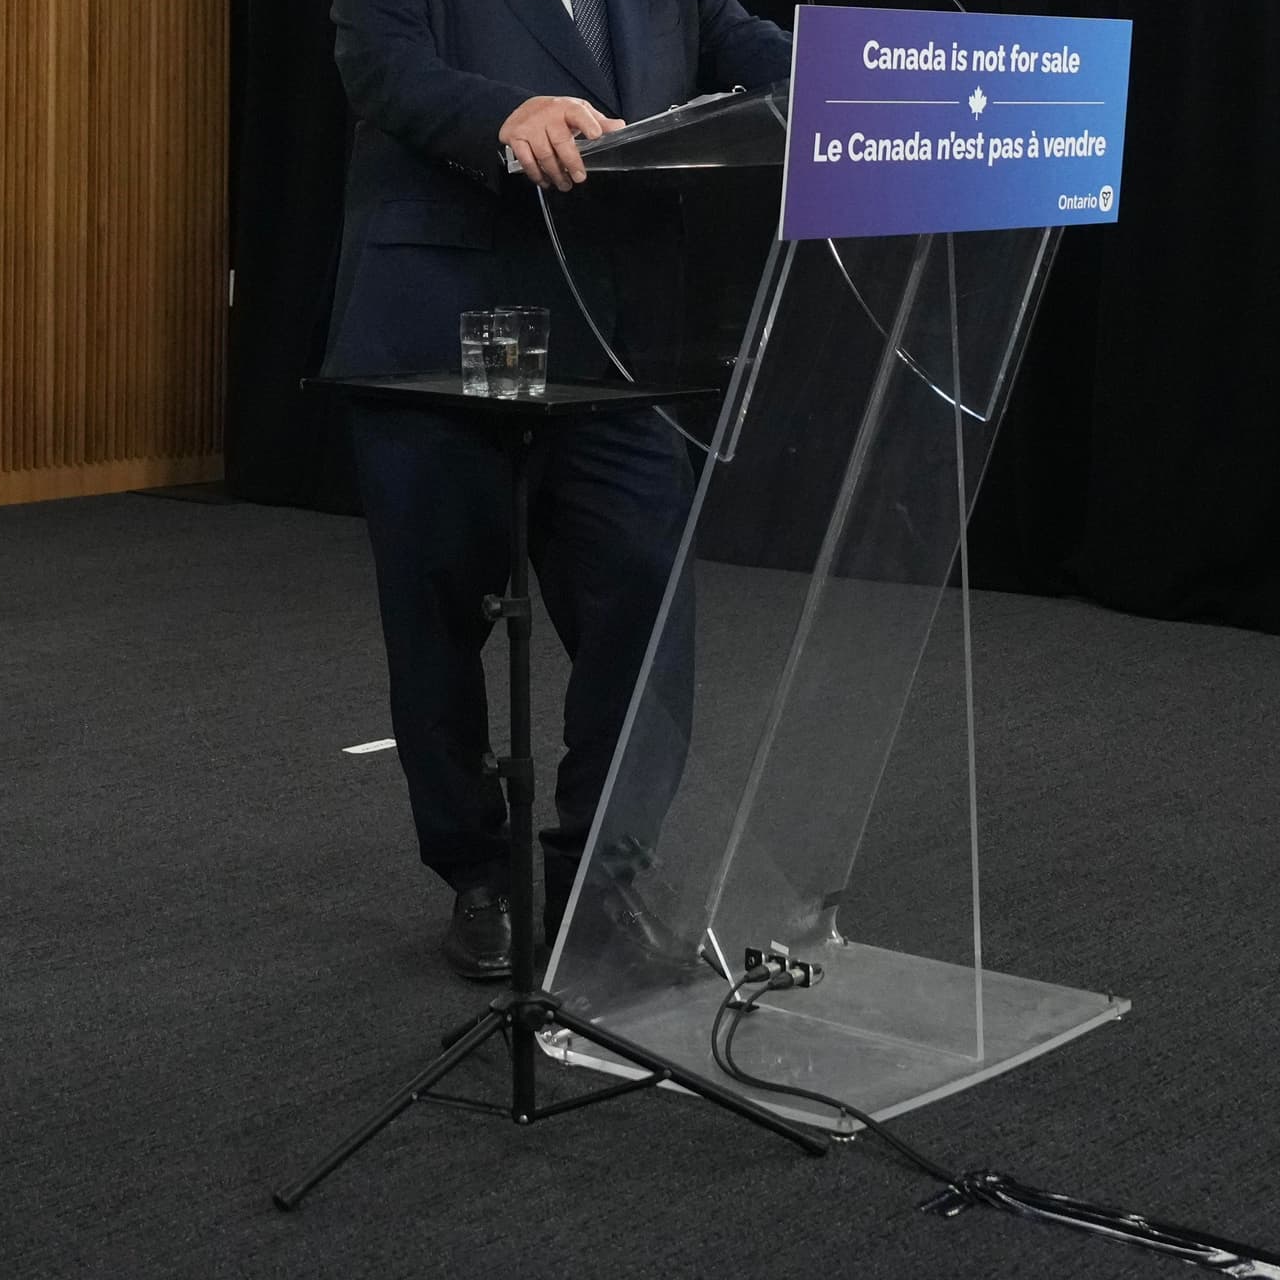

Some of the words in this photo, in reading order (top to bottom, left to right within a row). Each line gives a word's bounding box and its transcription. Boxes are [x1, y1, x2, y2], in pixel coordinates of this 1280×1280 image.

[862, 39, 946, 71] Canada
[951, 42, 968, 72] is
[972, 44, 1006, 72] not
[1010, 43, 1039, 73] for
[1040, 45, 1081, 74] sale
[813, 132, 843, 162] Le
[847, 131, 932, 162] Canada
[937, 131, 985, 160] n'est
[987, 137, 1024, 167] pas
[1027, 130, 1039, 158] à
[1043, 129, 1107, 158] vendre
[1057, 193, 1098, 210] Ontario
